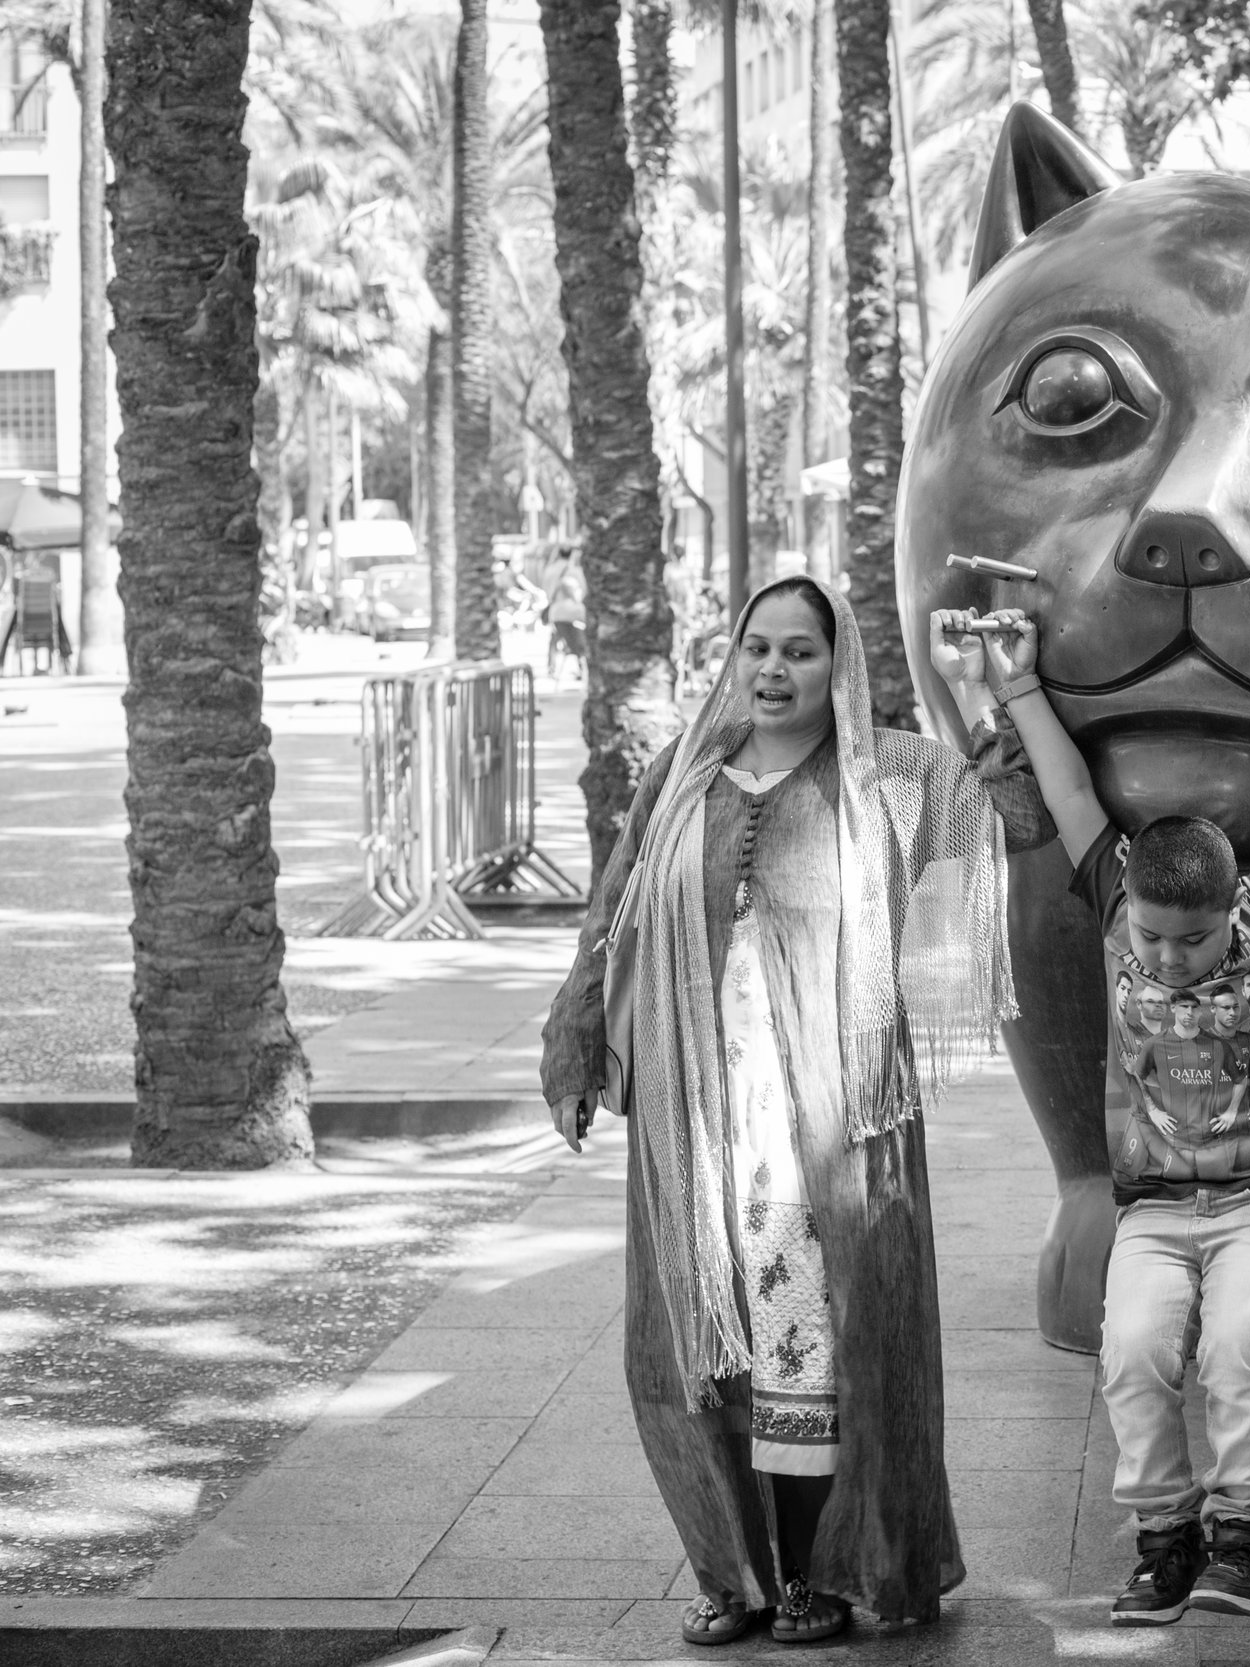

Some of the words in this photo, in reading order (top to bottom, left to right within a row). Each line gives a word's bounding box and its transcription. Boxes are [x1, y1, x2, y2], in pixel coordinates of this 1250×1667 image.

[1170, 1068, 1211, 1080] QATAR
[1181, 1077, 1212, 1085] AIRWAYS
[1128, 1138, 1137, 1155] 9
